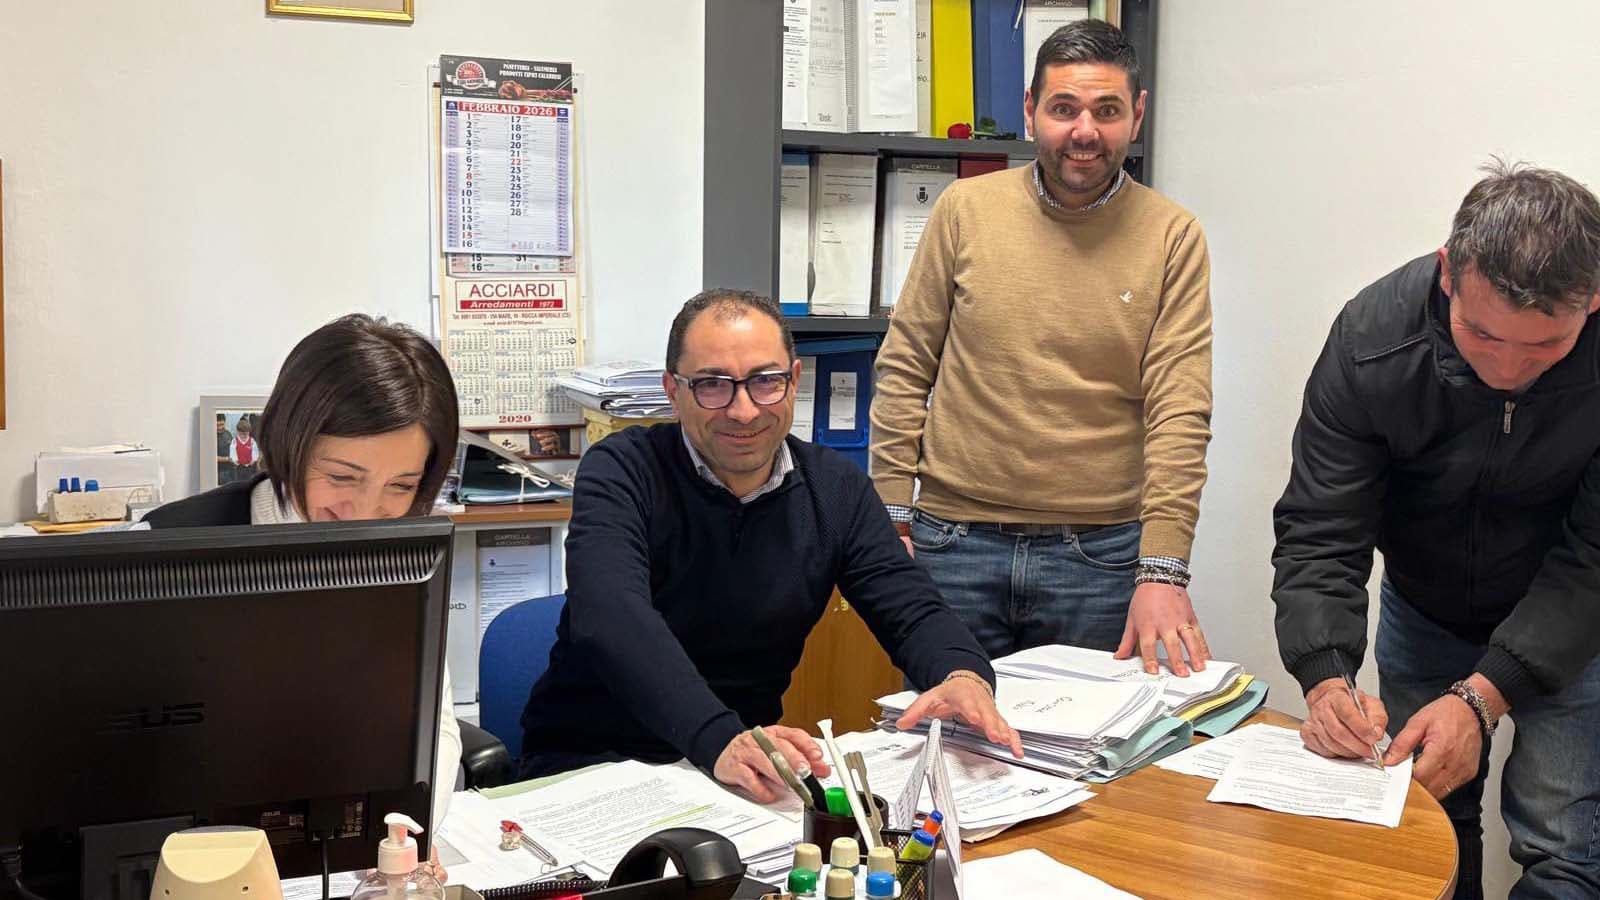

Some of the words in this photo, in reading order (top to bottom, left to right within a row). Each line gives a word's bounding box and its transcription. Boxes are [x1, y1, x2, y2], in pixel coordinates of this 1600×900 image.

[462, 102, 521, 114] FEBBRAIO
[524, 106, 553, 116] 2026
[466, 130, 472, 138] 3
[511, 133, 521, 141] 19
[466, 139, 472, 147] 4
[510, 166, 521, 174] 23
[510, 191, 521, 199] 26
[461, 206, 472, 214] 12
[510, 208, 521, 216] 28
[461, 223, 472, 231] 14
[461, 240, 472, 248] 16
[471, 254, 482, 262] 15
[471, 263, 482, 271] 16
[469, 283, 555, 297] ACCIARDI
[470, 301, 534, 309] Arredamenti
[499, 415, 532, 423] 2020
